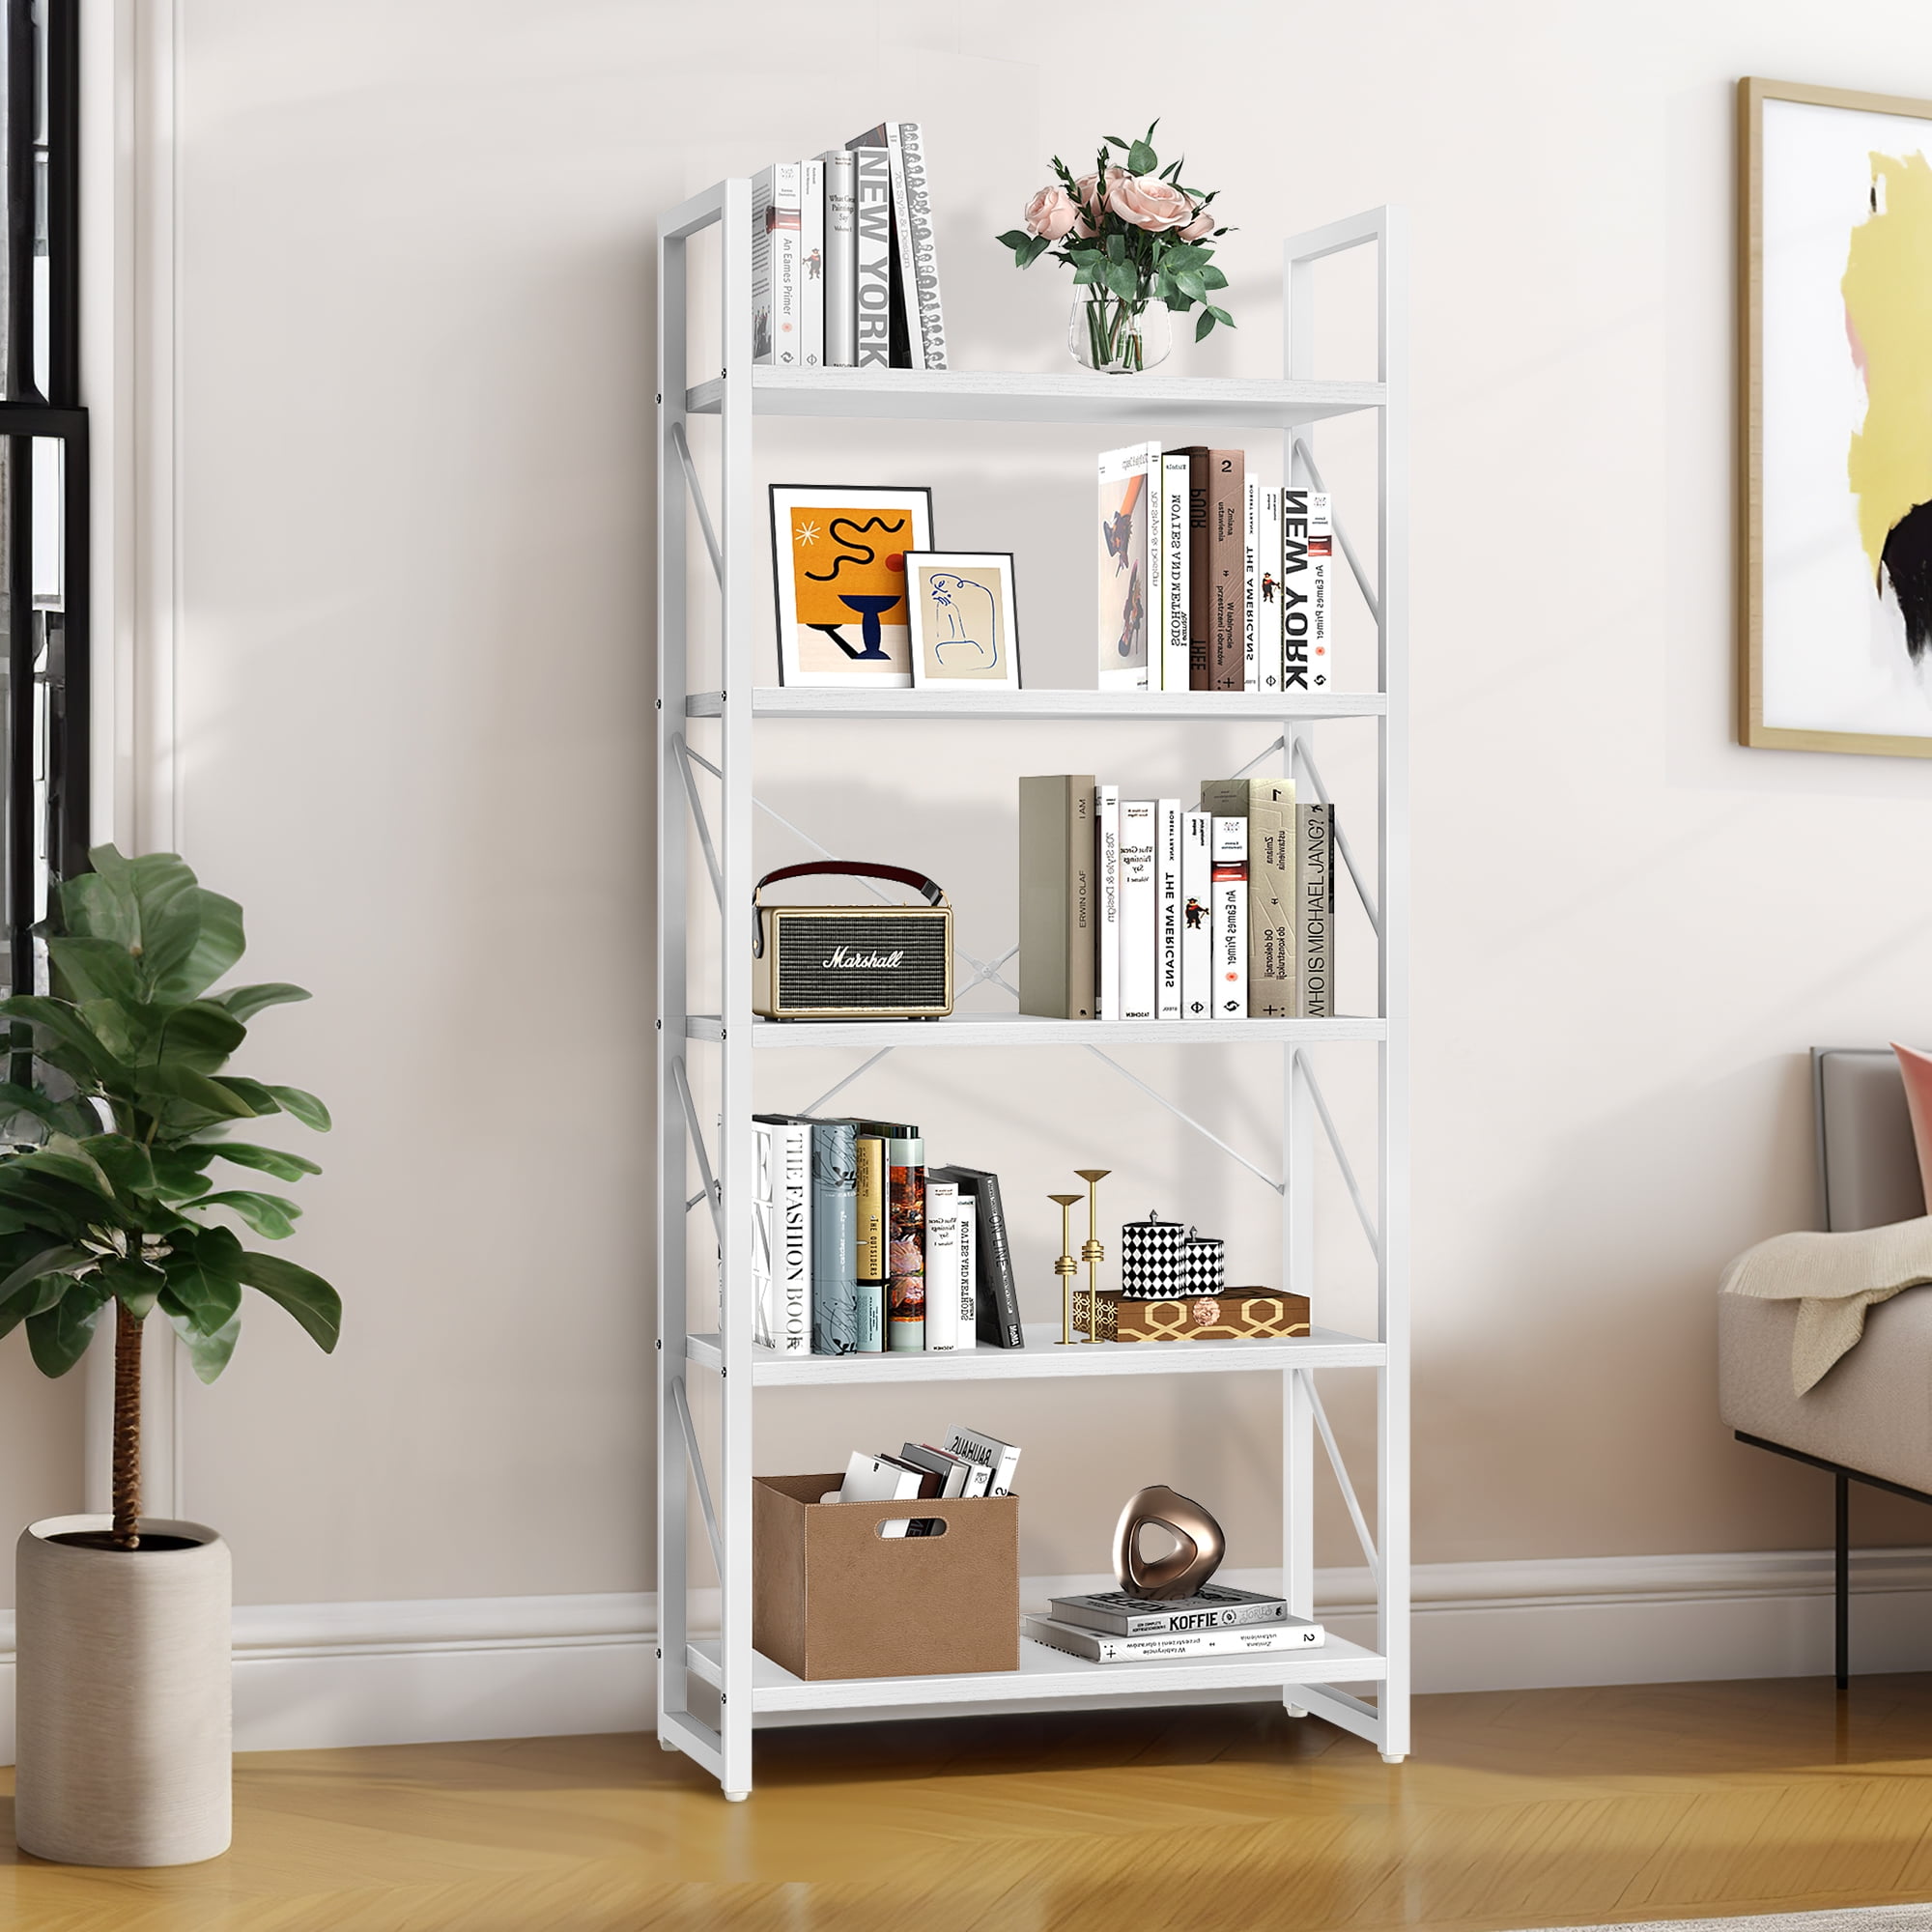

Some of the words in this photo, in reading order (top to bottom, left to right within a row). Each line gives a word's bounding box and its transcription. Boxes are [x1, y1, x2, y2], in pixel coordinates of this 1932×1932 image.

[859, 149, 889, 243] NEW
[895, 192, 906, 217] Style
[782, 238, 793, 253] An
[899, 230, 911, 270] Design
[782, 254, 793, 285] Eames
[782, 286, 793, 316] Primer
[859, 256, 889, 369] YORK
[1221, 460, 1233, 473] 2
[1215, 585, 1225, 628] przestrzeni
[1227, 602, 1235, 611] W
[1225, 611, 1235, 649] labiryncie
[1078, 799, 1086, 815] AM
[1308, 819, 1324, 874] JANG?
[1078, 870, 1087, 895] OLAF
[1078, 896, 1087, 928] ERWIN
[1308, 875, 1324, 953] MICHAEL
[822, 945, 904, 968] Marshall
[1308, 956, 1324, 973] IS
[1307, 977, 1324, 1018] WHO
[786, 1133, 804, 1180] THE
[785, 1184, 804, 1281] FASHION
[869, 1219, 879, 1232] THE
[989, 1215, 1003, 1234] ON
[869, 1236, 878, 1276] OUTSIDERS
[786, 1289, 804, 1350] BOOK
[1009, 1324, 1020, 1347] MoMA
[1169, 1611, 1218, 1632] KOFFIE
[1126, 1641, 1156, 1650] obrazów
[1161, 1637, 1201, 1647] przestrzeni
[1240, 1633, 1278, 1642] ustawienia
[1303, 1633, 1316, 1642] 2
